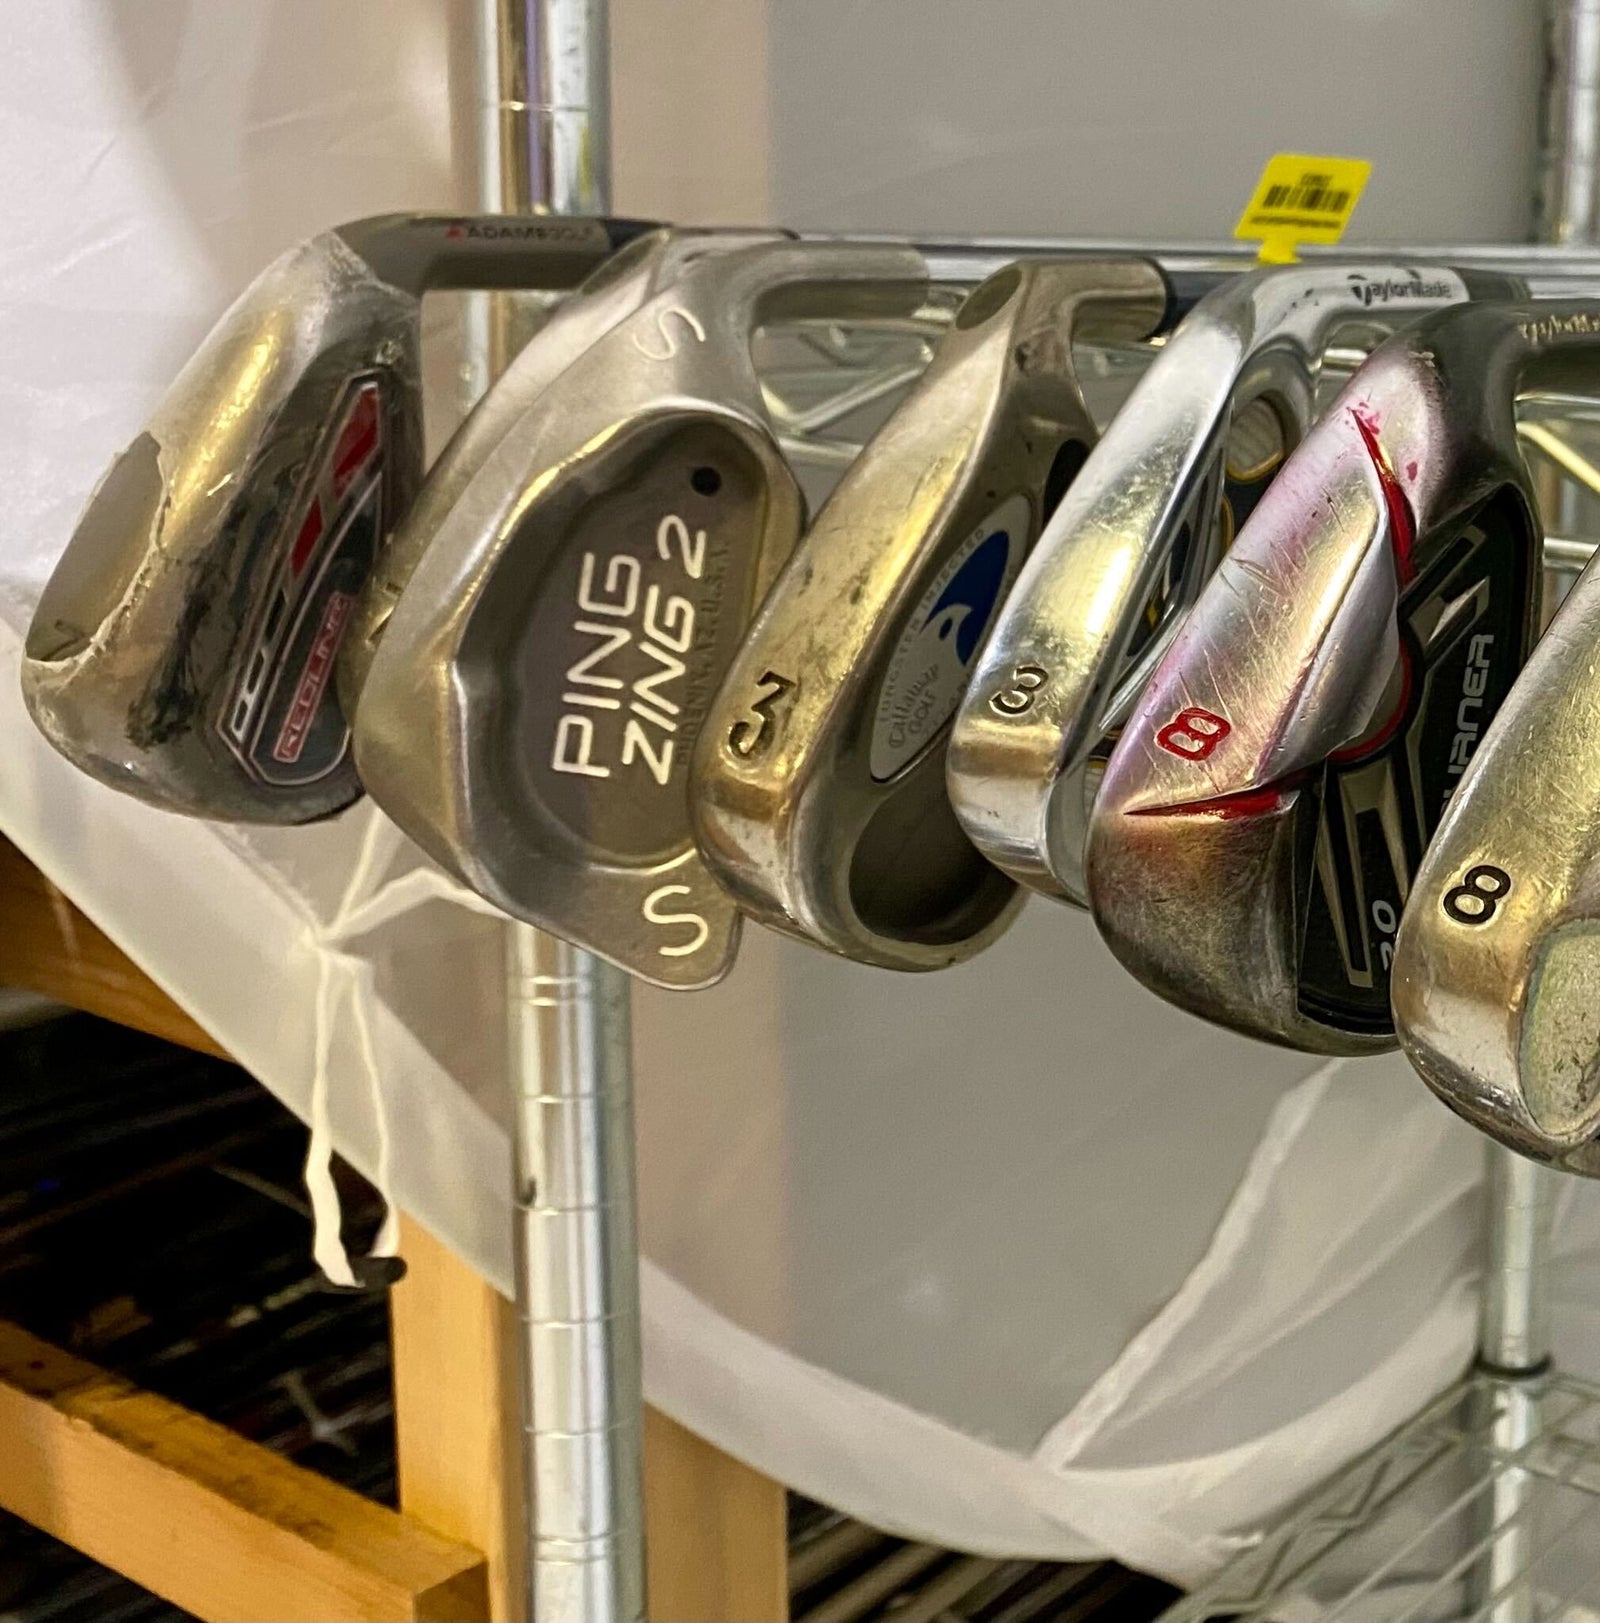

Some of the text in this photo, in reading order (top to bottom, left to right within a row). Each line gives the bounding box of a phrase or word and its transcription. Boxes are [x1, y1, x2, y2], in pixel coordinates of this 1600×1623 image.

[631, 306, 706, 360] S
[552, 551, 640, 778] PING
[622, 514, 706, 785] ZING 2
[728, 671, 796, 762] 3
[989, 666, 1048, 717] 3
[1156, 707, 1231, 761] 8
[643, 885, 708, 956] S
[1443, 864, 1512, 925] 8
